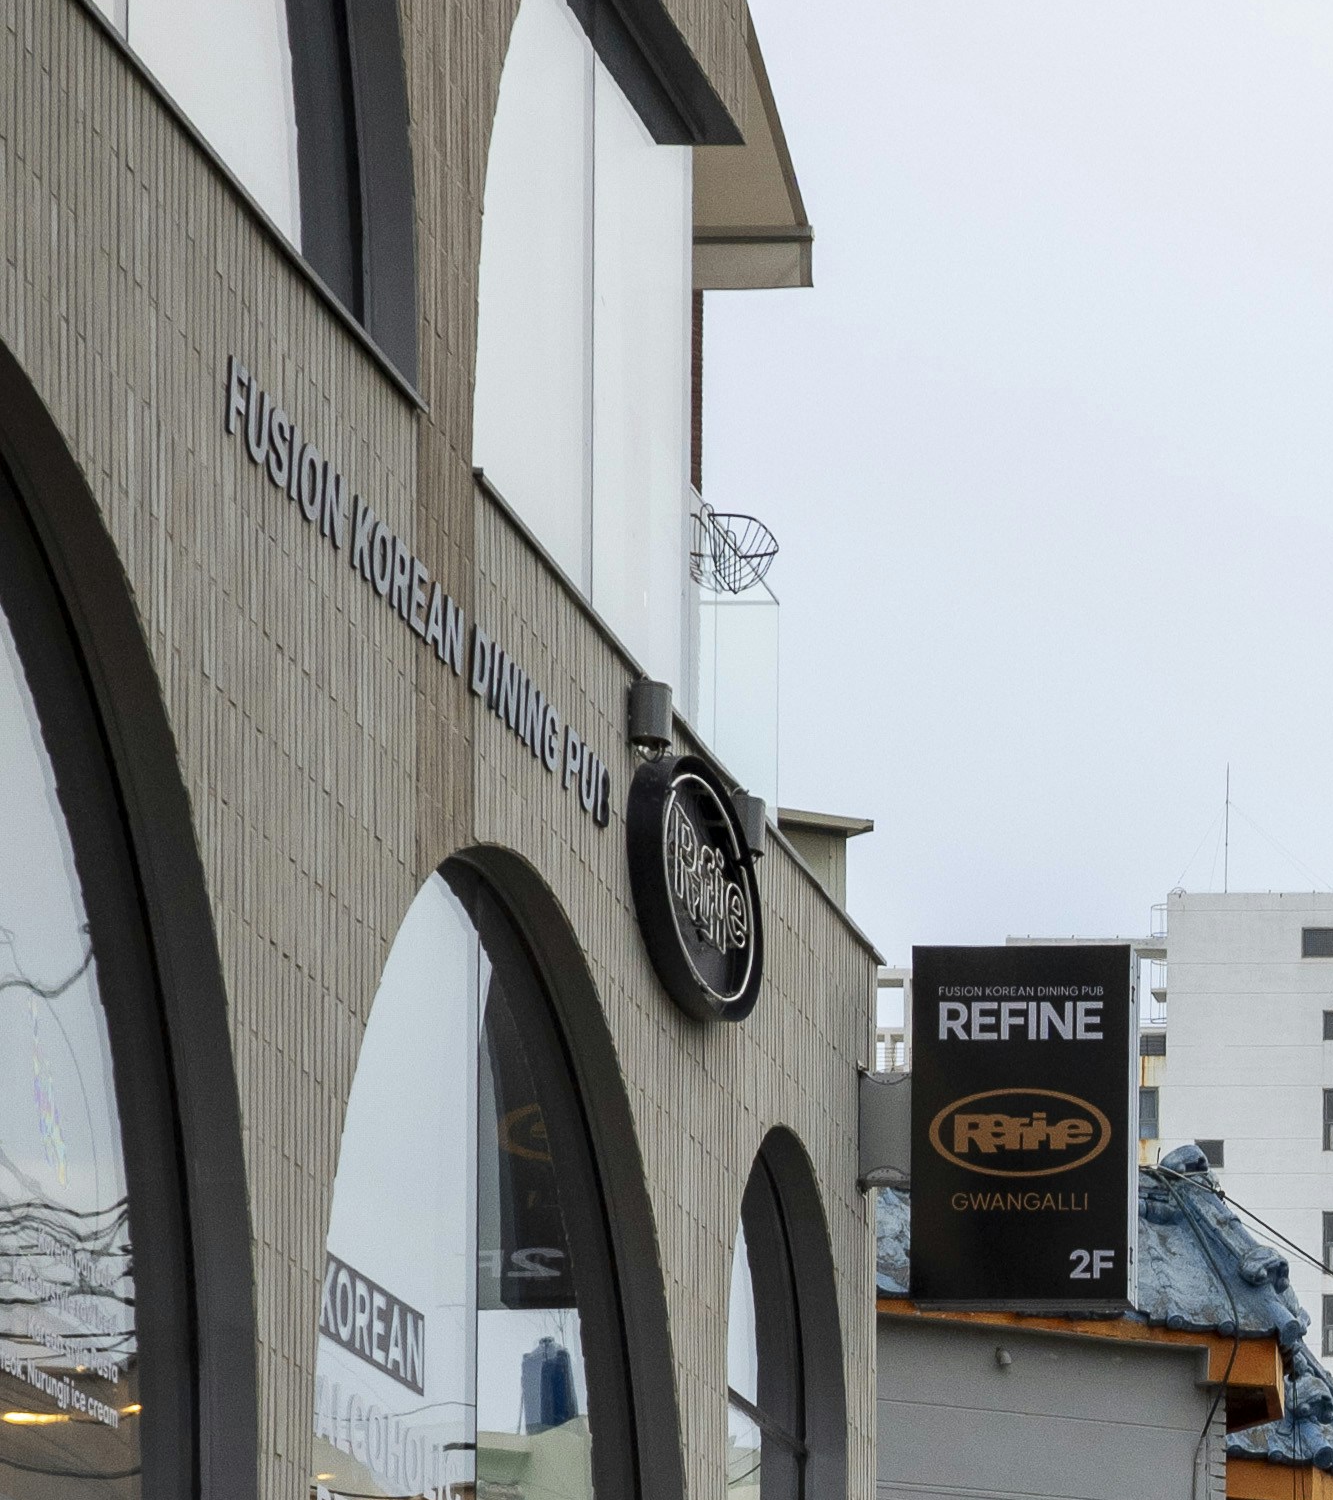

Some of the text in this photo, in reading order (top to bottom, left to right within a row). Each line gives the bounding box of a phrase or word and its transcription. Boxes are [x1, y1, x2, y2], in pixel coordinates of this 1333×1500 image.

[225, 355, 611, 828] FUSION KOREAN DINING PUB
[938, 985, 1104, 997] FUSION KOREAN DINING PUB
[938, 1000, 1104, 1041] REFINE
[951, 1192, 1089, 1211] GWANGALLI
[1068, 1249, 1116, 1280] 2F
[320, 1258, 425, 1392] KOREAN
[27, 1358, 71, 1410] Nurungji
[71, 1379, 86, 1412] ice
[87, 1396, 119, 1430] cream
